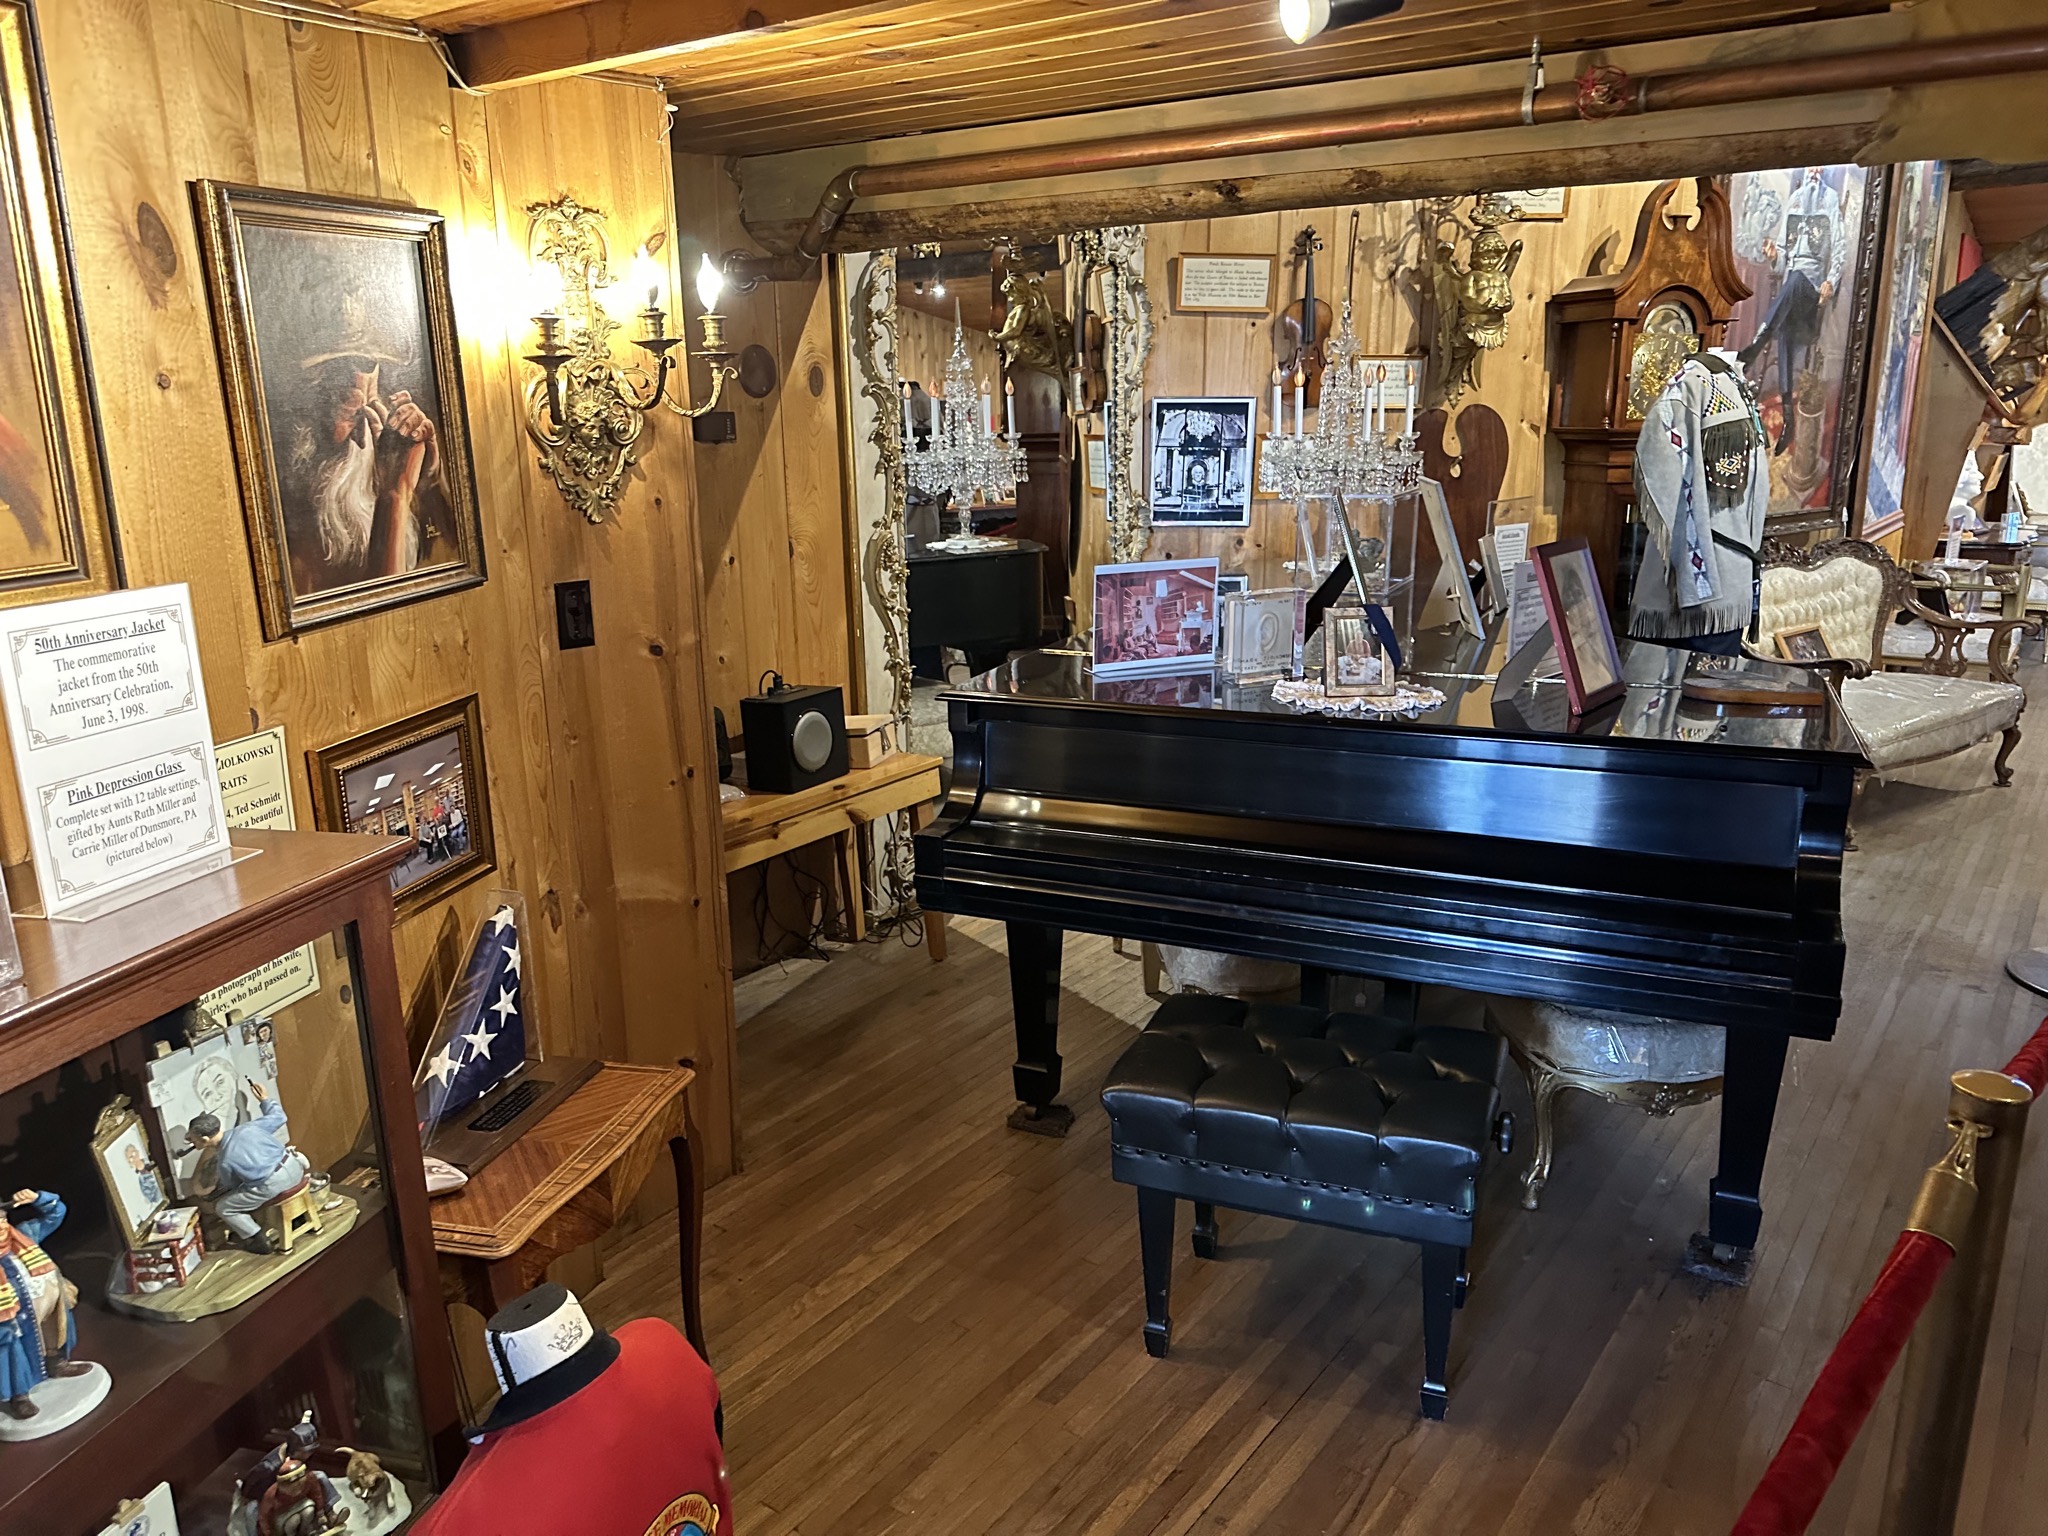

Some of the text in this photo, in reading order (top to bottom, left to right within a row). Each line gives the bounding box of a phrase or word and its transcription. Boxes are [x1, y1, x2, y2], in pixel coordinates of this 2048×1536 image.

[34, 618, 165, 652] 50th Anniversary Jacket
[53, 643, 156, 672] The commemorative
[58, 660, 159, 696] jacket from the 50th
[50, 679, 173, 716] Anniversary Celebration,
[82, 703, 148, 729] June 3, 1998.
[67, 761, 183, 803] Pink Depression Glass
[56, 777, 200, 828] Complete set with 12 table settings,
[67, 792, 197, 845] gifted by Aunts Ruth Miller and
[235, 803, 249, 815] Ted
[251, 792, 280, 810] Schmidt
[251, 805, 283, 825] beautiful
[72, 809, 197, 859] Carrie Miller of Dunsmore, PA
[106, 833, 173, 866] (pictured below)
[218, 968, 261, 998] photograph
[263, 965, 271, 974] of
[273, 959, 283, 968] his
[284, 950, 301, 962] wife,
[231, 992, 247, 1005] who
[249, 984, 262, 997] had
[265, 973, 288, 990] passed
[290, 966, 301, 974] on.
[664, 1499, 708, 1526] MEMORIAL
